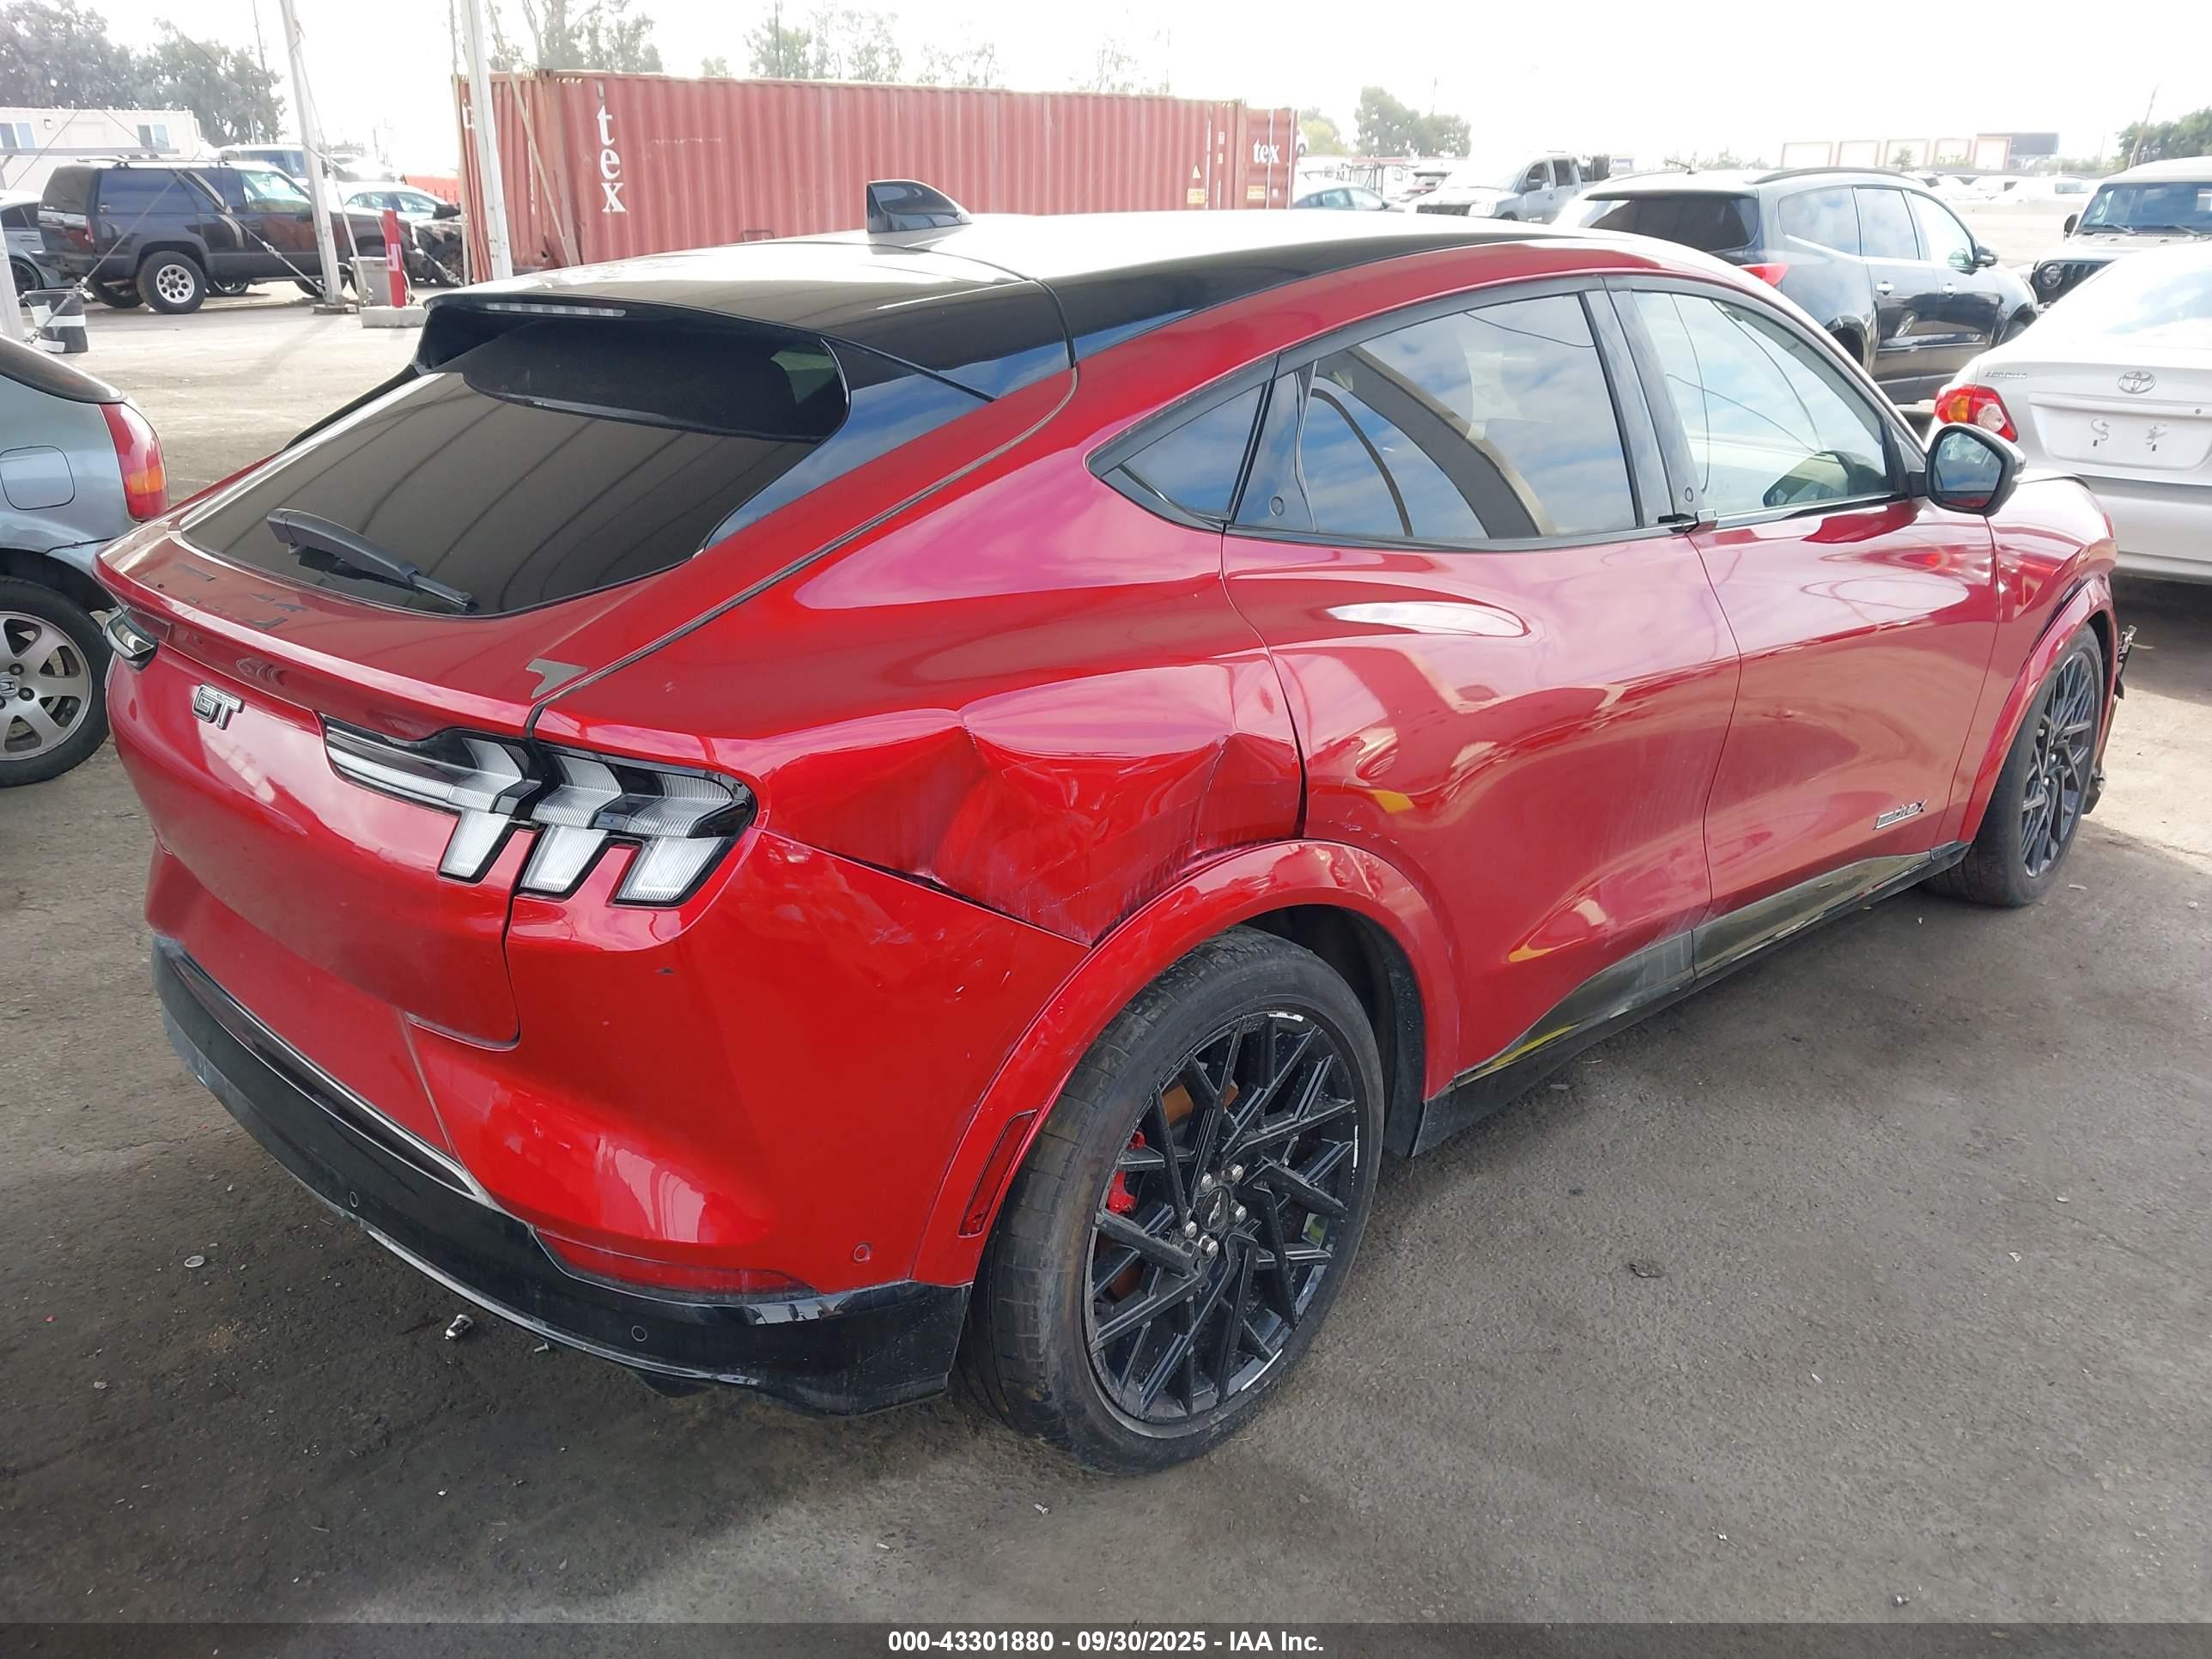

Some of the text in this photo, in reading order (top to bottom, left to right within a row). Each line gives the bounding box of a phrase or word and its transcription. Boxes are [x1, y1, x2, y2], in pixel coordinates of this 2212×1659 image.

[597, 104, 627, 213] tex
[1253, 137, 1280, 165] tex
[192, 684, 244, 730] GT
